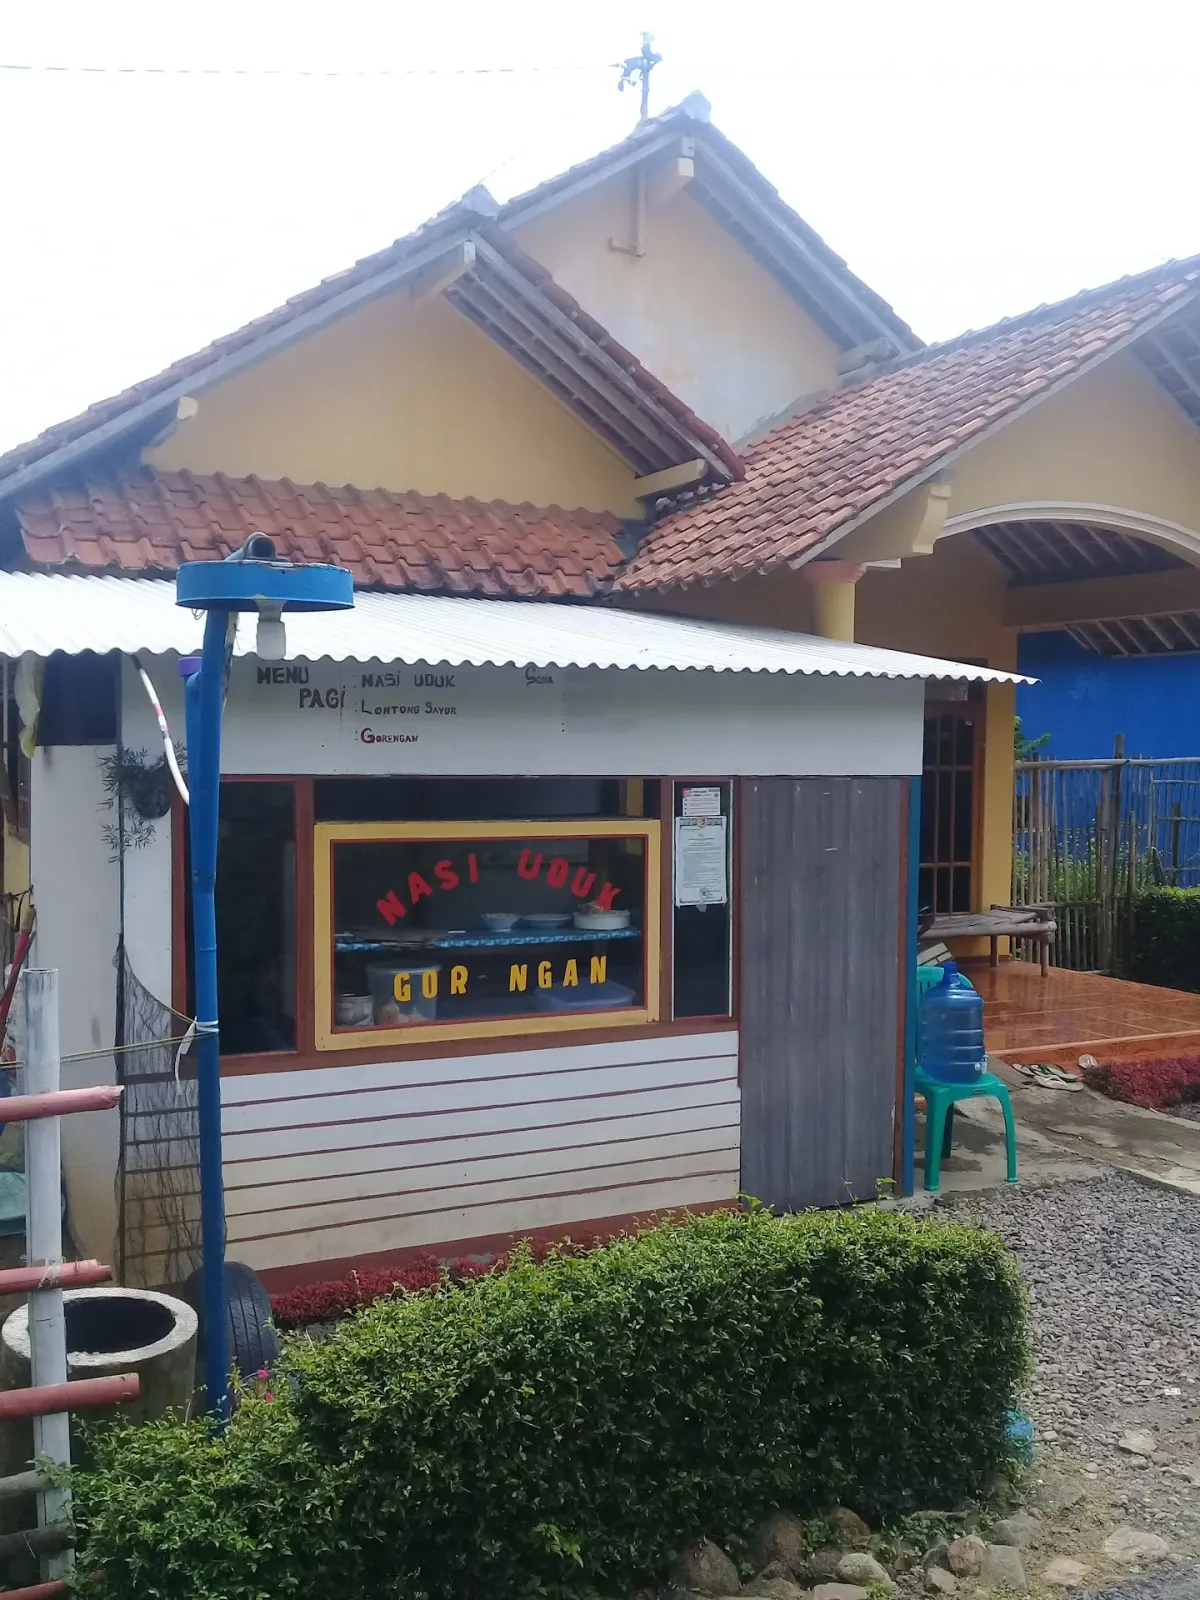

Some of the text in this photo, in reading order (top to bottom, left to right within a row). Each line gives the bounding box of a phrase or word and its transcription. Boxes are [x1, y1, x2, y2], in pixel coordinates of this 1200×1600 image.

[256, 666, 310, 685] MENU
[414, 673, 456, 688] UDUK
[376, 853, 479, 926] NASI
[516, 848, 621, 912] UDUK
